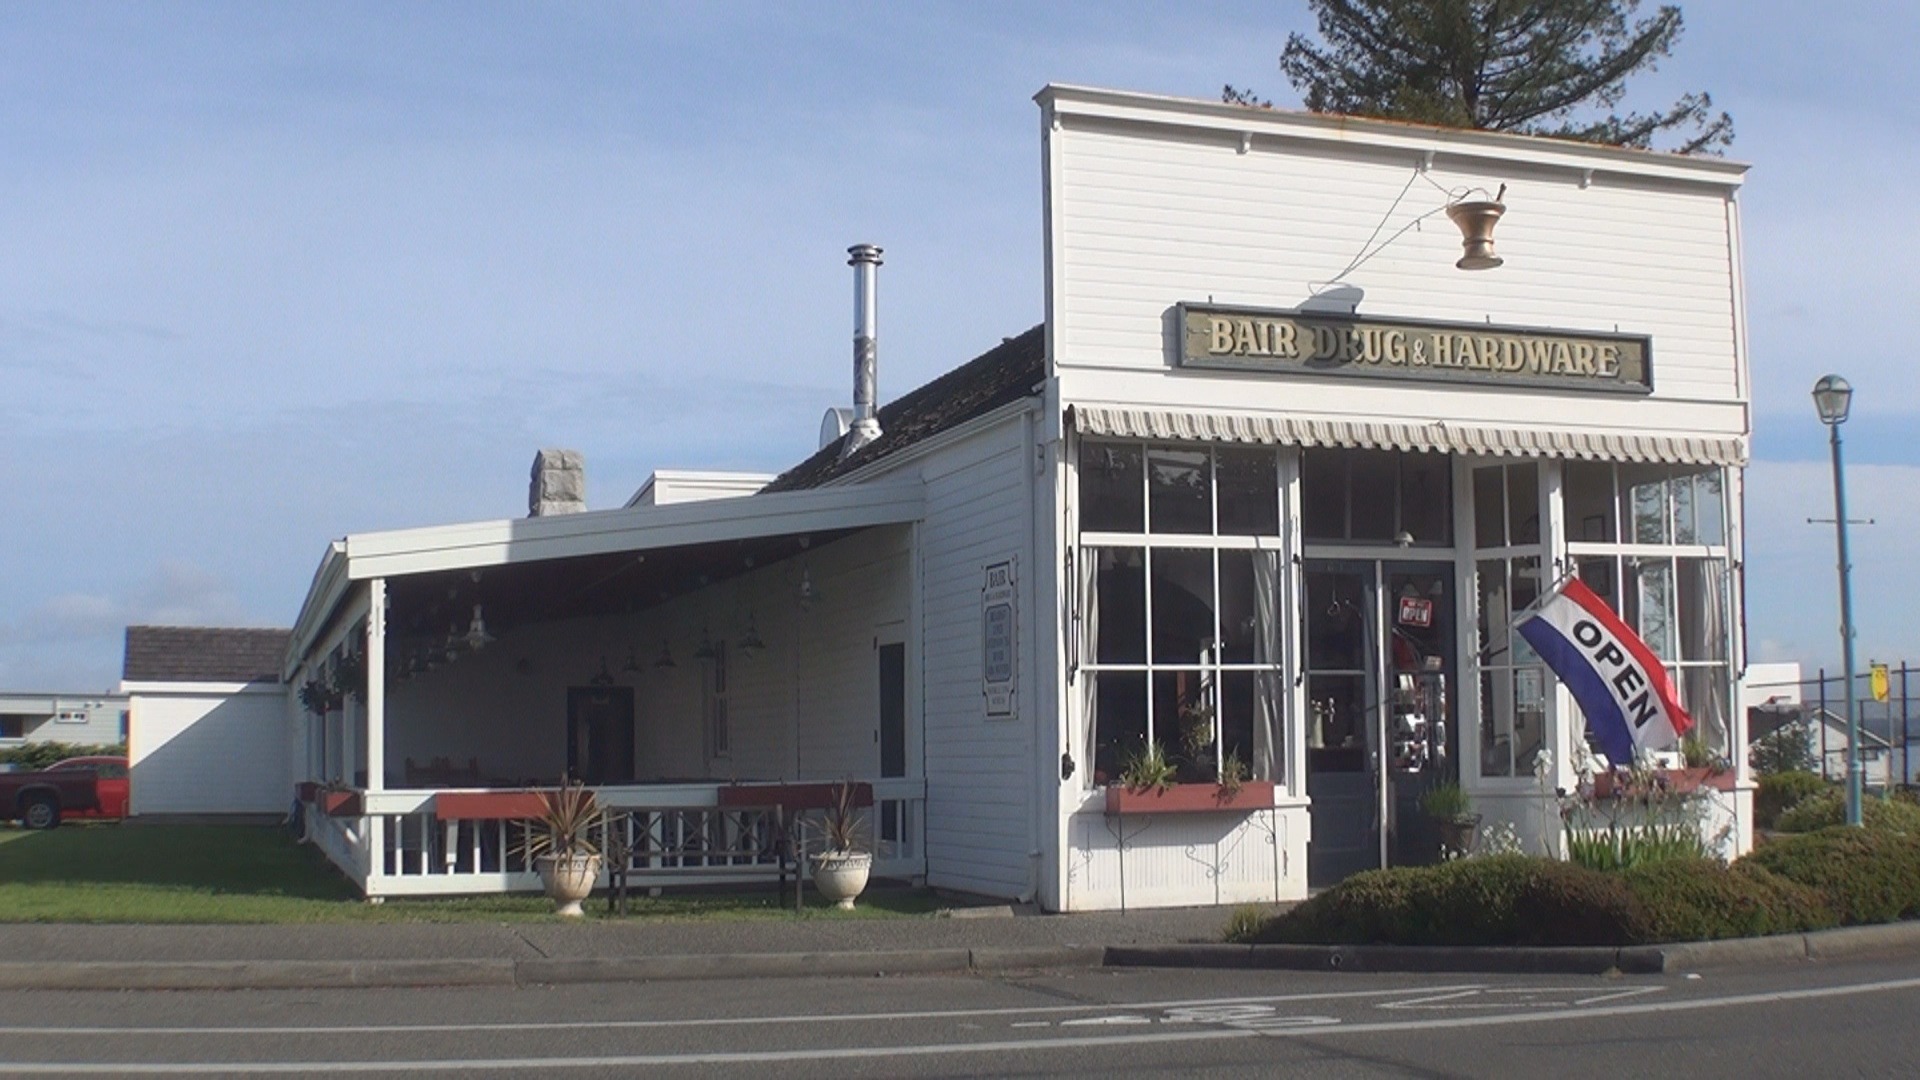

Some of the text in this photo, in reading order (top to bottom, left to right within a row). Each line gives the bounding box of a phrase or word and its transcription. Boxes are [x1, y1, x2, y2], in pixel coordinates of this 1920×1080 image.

[1208, 317, 1622, 379] BAIR DRUG & HARDWARE
[1402, 605, 1428, 622] OPEN
[1572, 619, 1658, 729] OPEN
